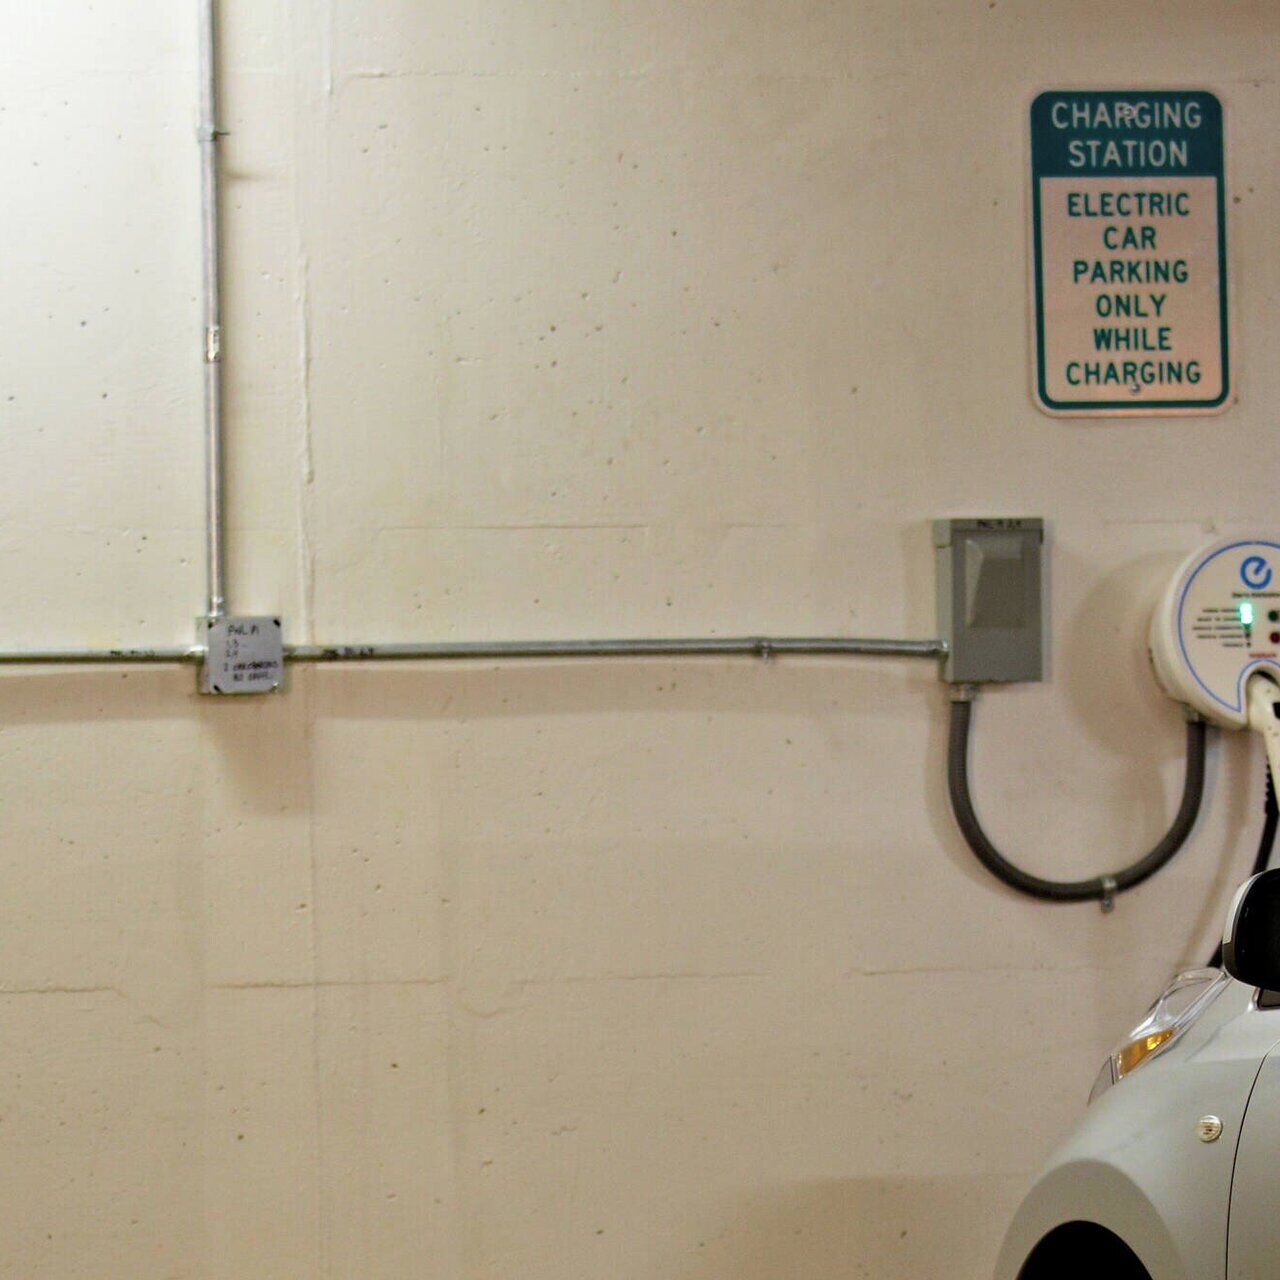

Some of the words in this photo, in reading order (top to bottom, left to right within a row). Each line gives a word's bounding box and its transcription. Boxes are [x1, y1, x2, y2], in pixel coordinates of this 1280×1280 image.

[1051, 101, 1202, 129] CHARGING
[1068, 140, 1188, 168] STATION
[1067, 192, 1190, 217] ELECTRIC
[1103, 226, 1157, 250] CAR
[1072, 260, 1188, 284] PARKING
[1095, 293, 1167, 318] ONLY
[1093, 327, 1172, 351] WHILE
[1066, 361, 1201, 385] CHARGING
